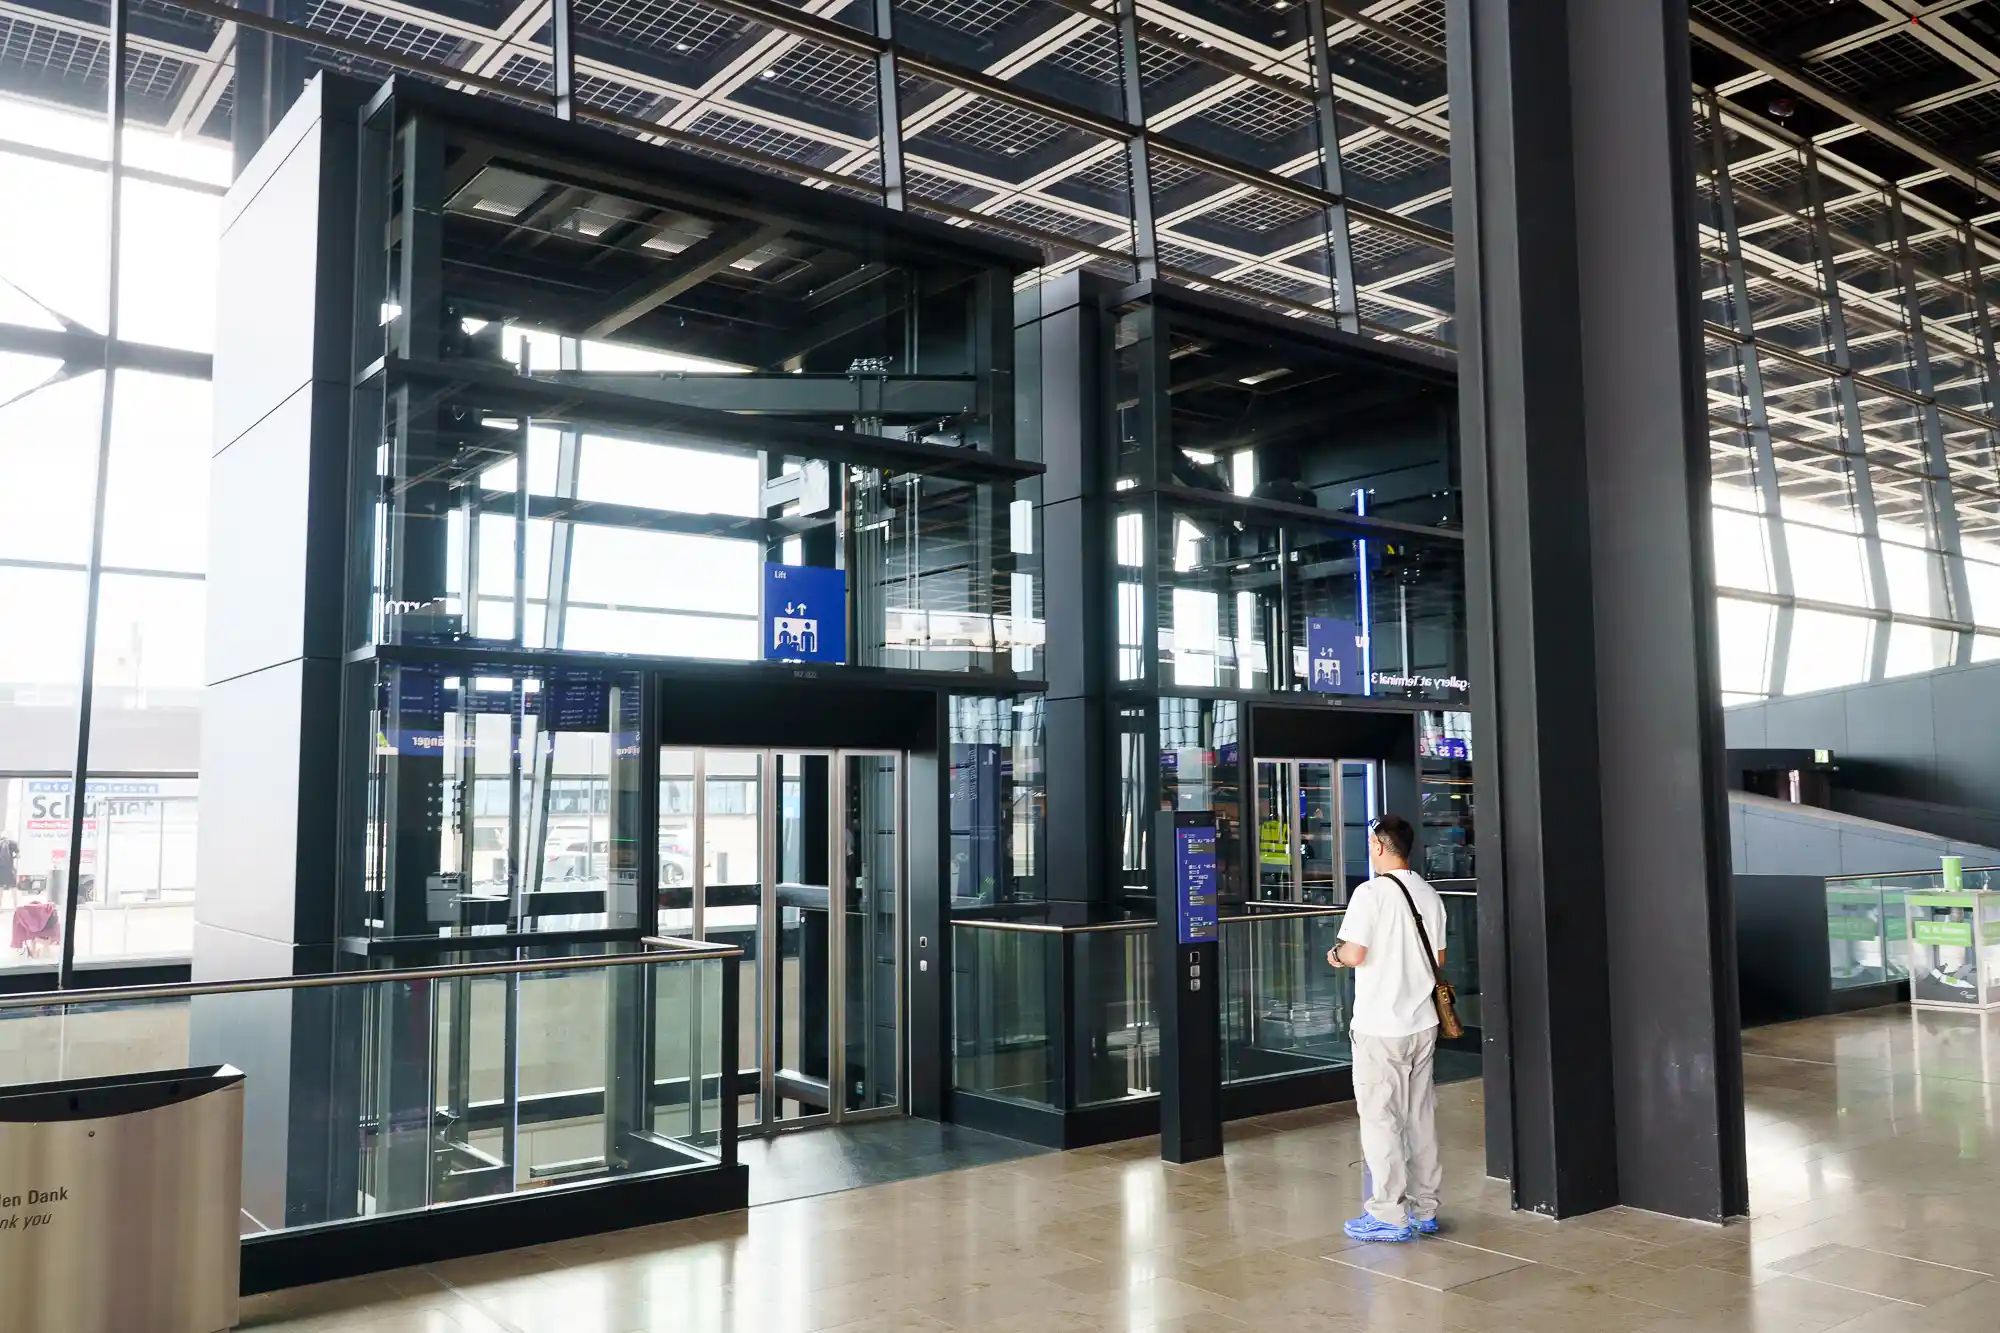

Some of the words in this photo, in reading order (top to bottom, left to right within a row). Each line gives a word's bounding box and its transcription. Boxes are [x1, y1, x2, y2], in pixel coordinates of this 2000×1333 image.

[774, 570, 787, 579] Lift
[28, 1186, 69, 1205] Dank
[22, 1213, 53, 1231] you
